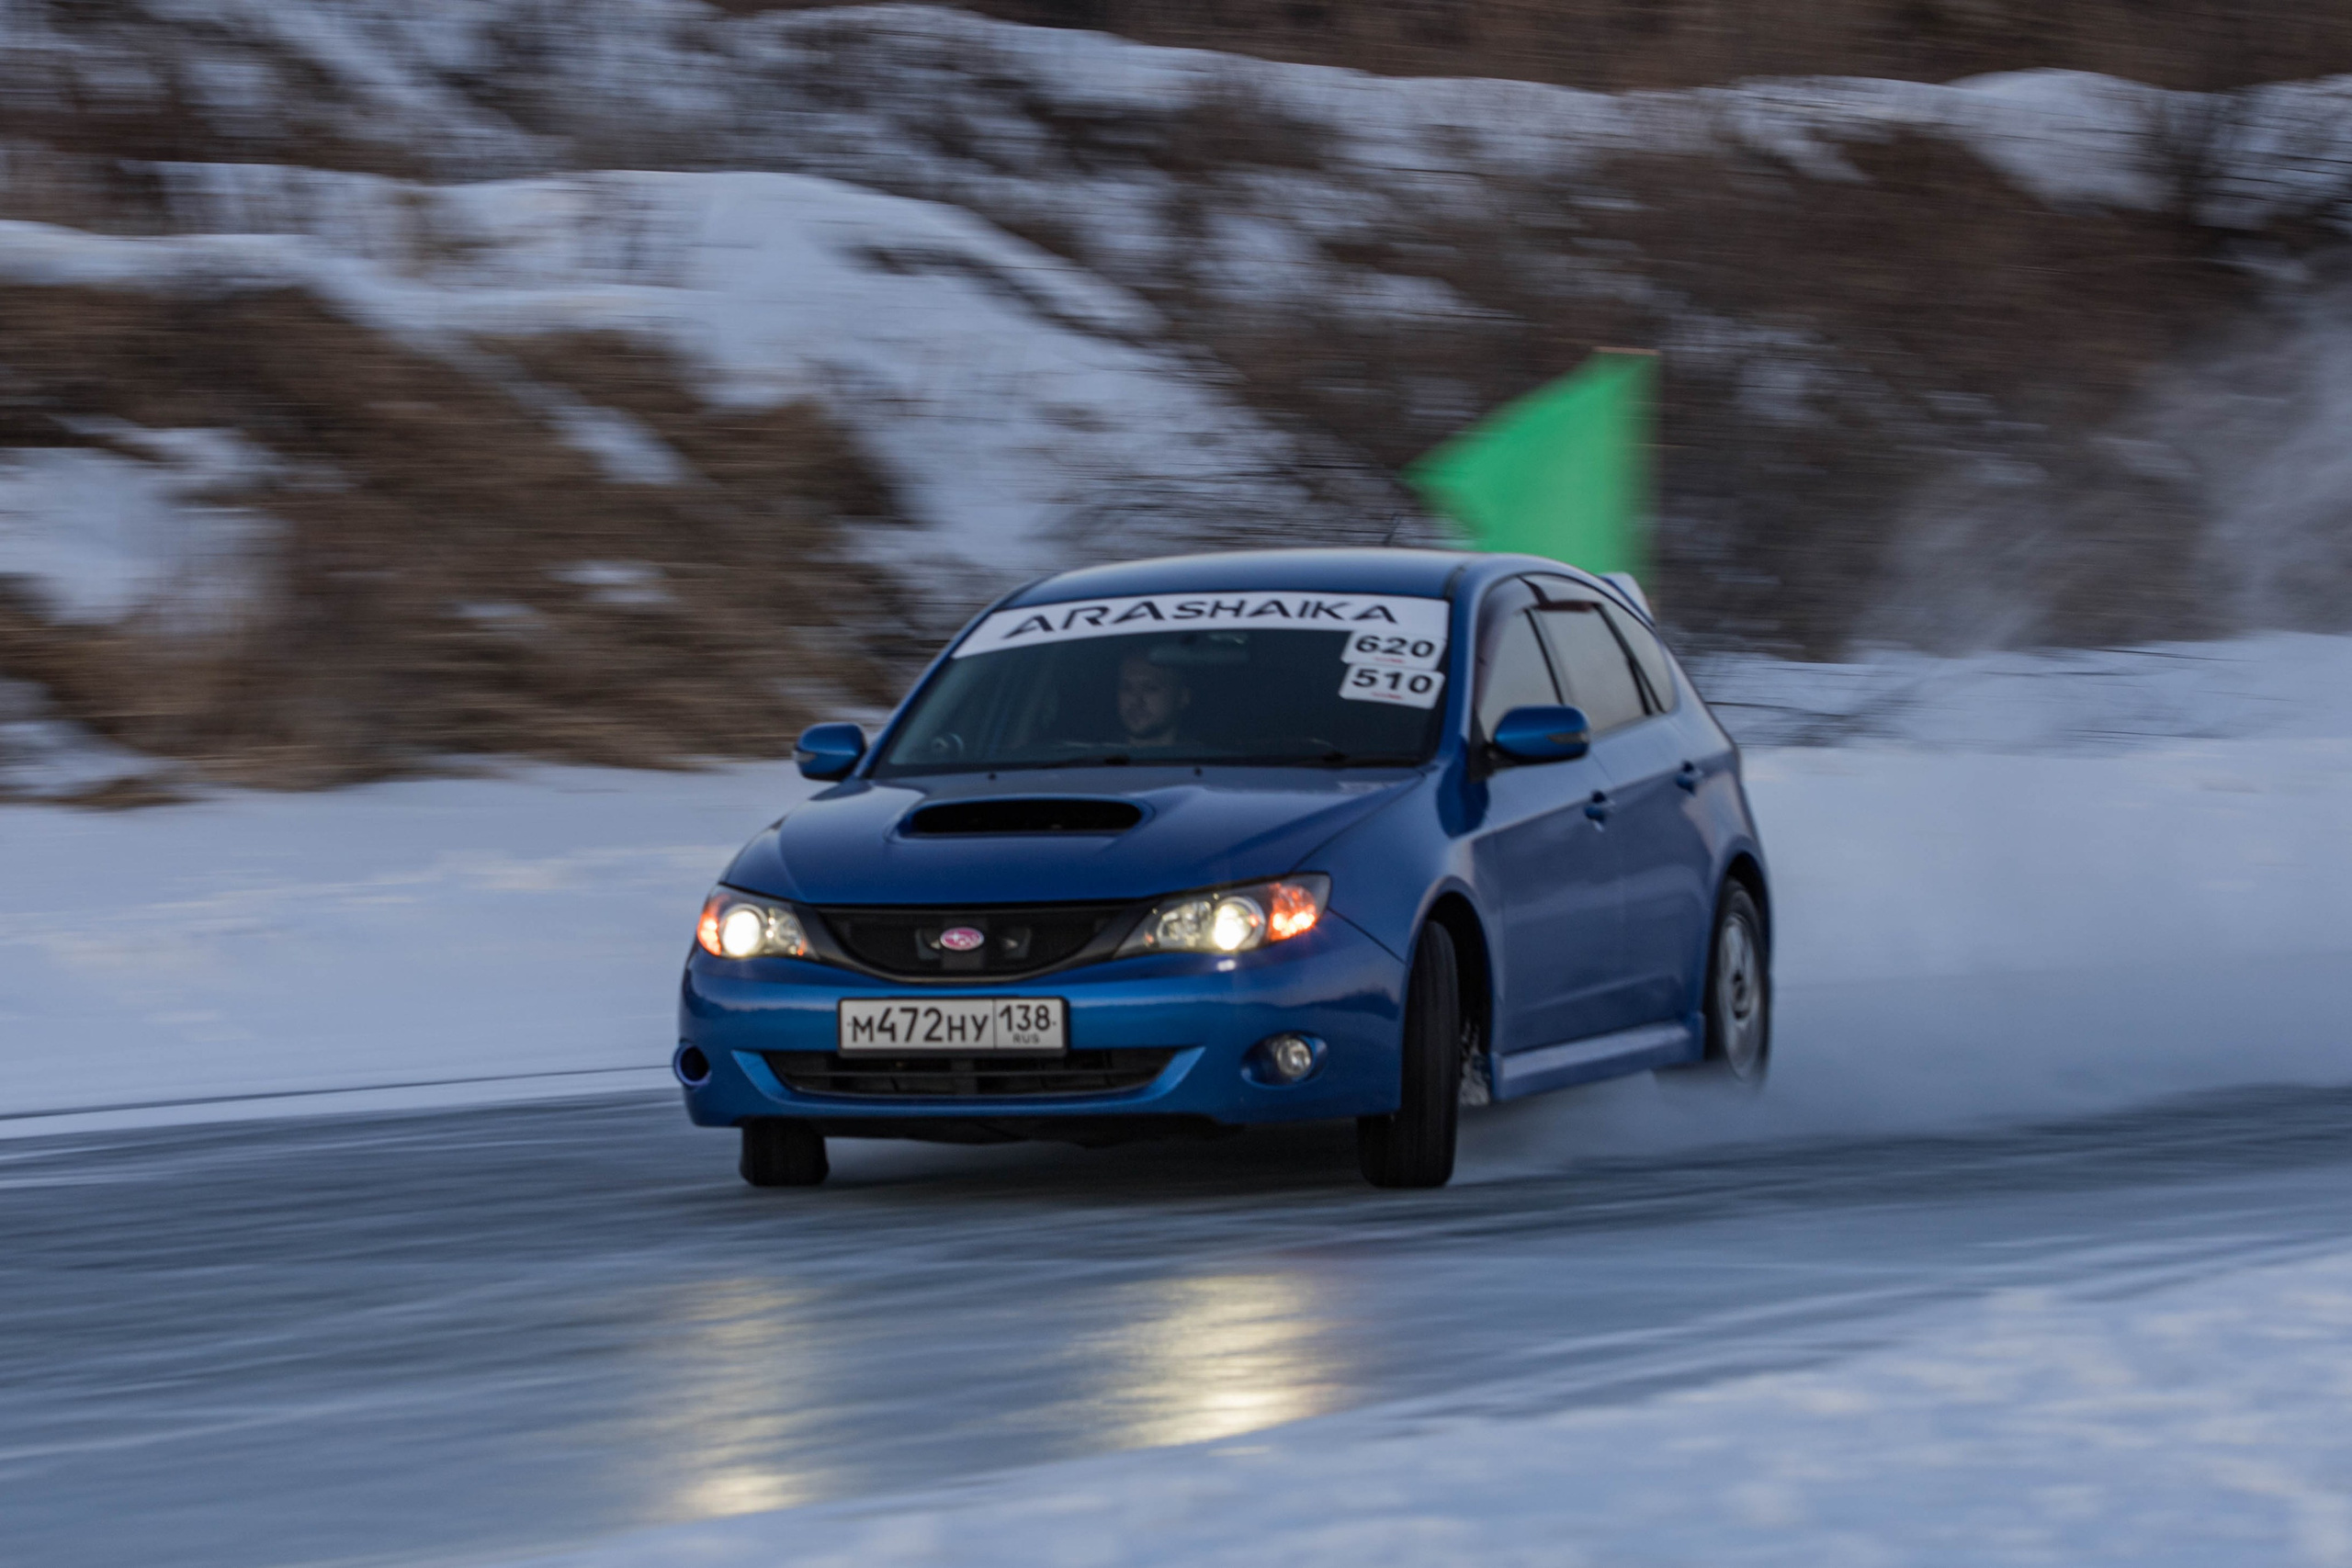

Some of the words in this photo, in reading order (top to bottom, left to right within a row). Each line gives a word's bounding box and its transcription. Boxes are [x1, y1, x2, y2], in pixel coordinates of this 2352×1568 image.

[1002, 600, 1398, 639] ARASHAIKA
[1355, 635, 1434, 658] 620
[1351, 669, 1433, 694] 510
[852, 1007, 989, 1043] М472НУ
[999, 1005, 1050, 1032] 138
[1012, 1033, 1040, 1044] RUS
